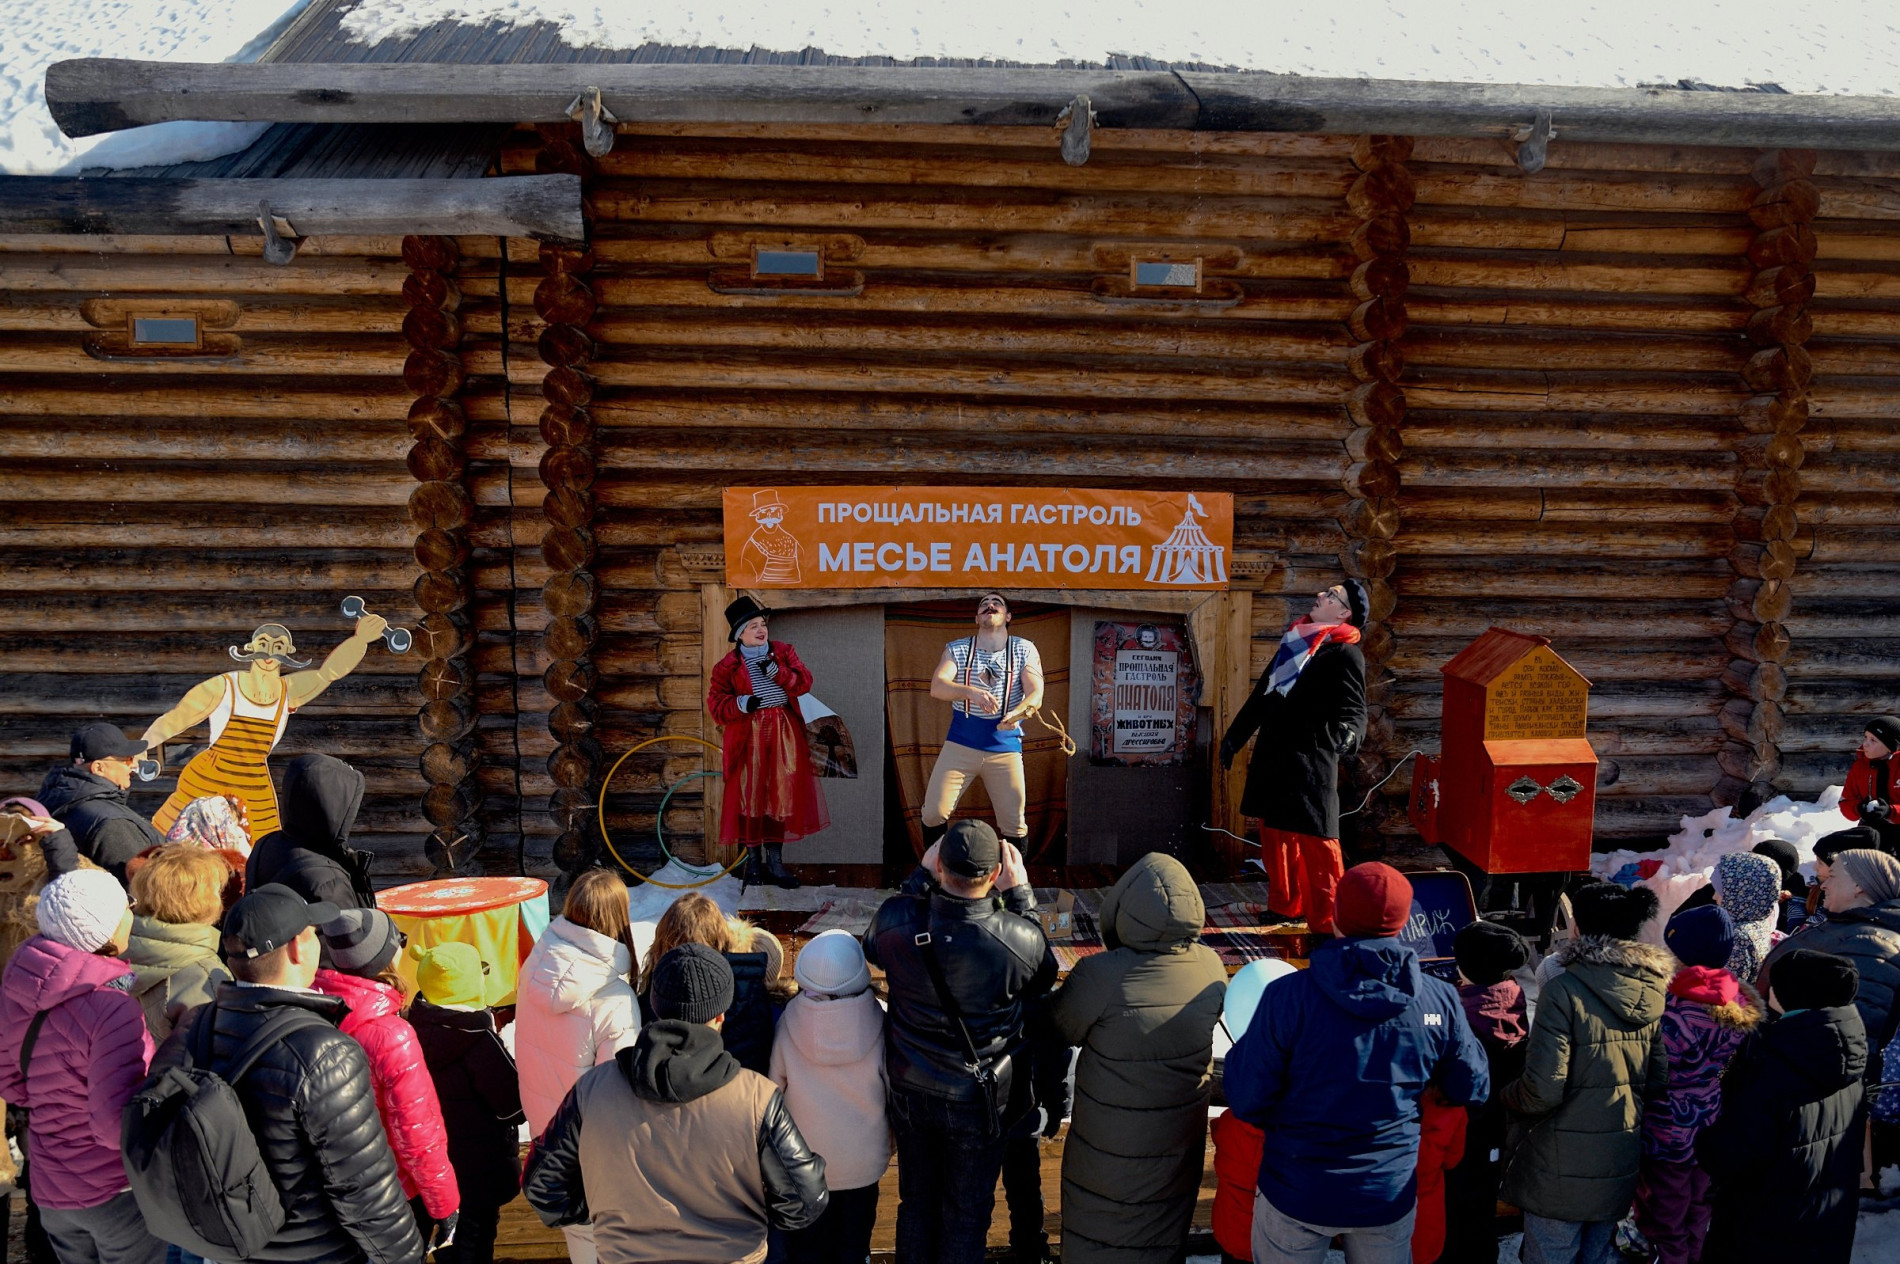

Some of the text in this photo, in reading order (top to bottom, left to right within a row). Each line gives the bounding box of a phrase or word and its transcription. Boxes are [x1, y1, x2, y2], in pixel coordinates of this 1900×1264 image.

[818, 503, 1142, 527] ПРОЩАЛЬНАЯ ГАСТРОЛЬ
[818, 542, 1142, 574] МЕСЬЕ АНАТОЛЯ
[1118, 662, 1174, 673] ПРОЩАЛЬНАЯ
[1125, 672, 1167, 681] ГАСТРОЛЬ
[1116, 684, 1175, 711] АНАТОЛЯ
[1117, 719, 1174, 730] ЖИВОТНЫХ
